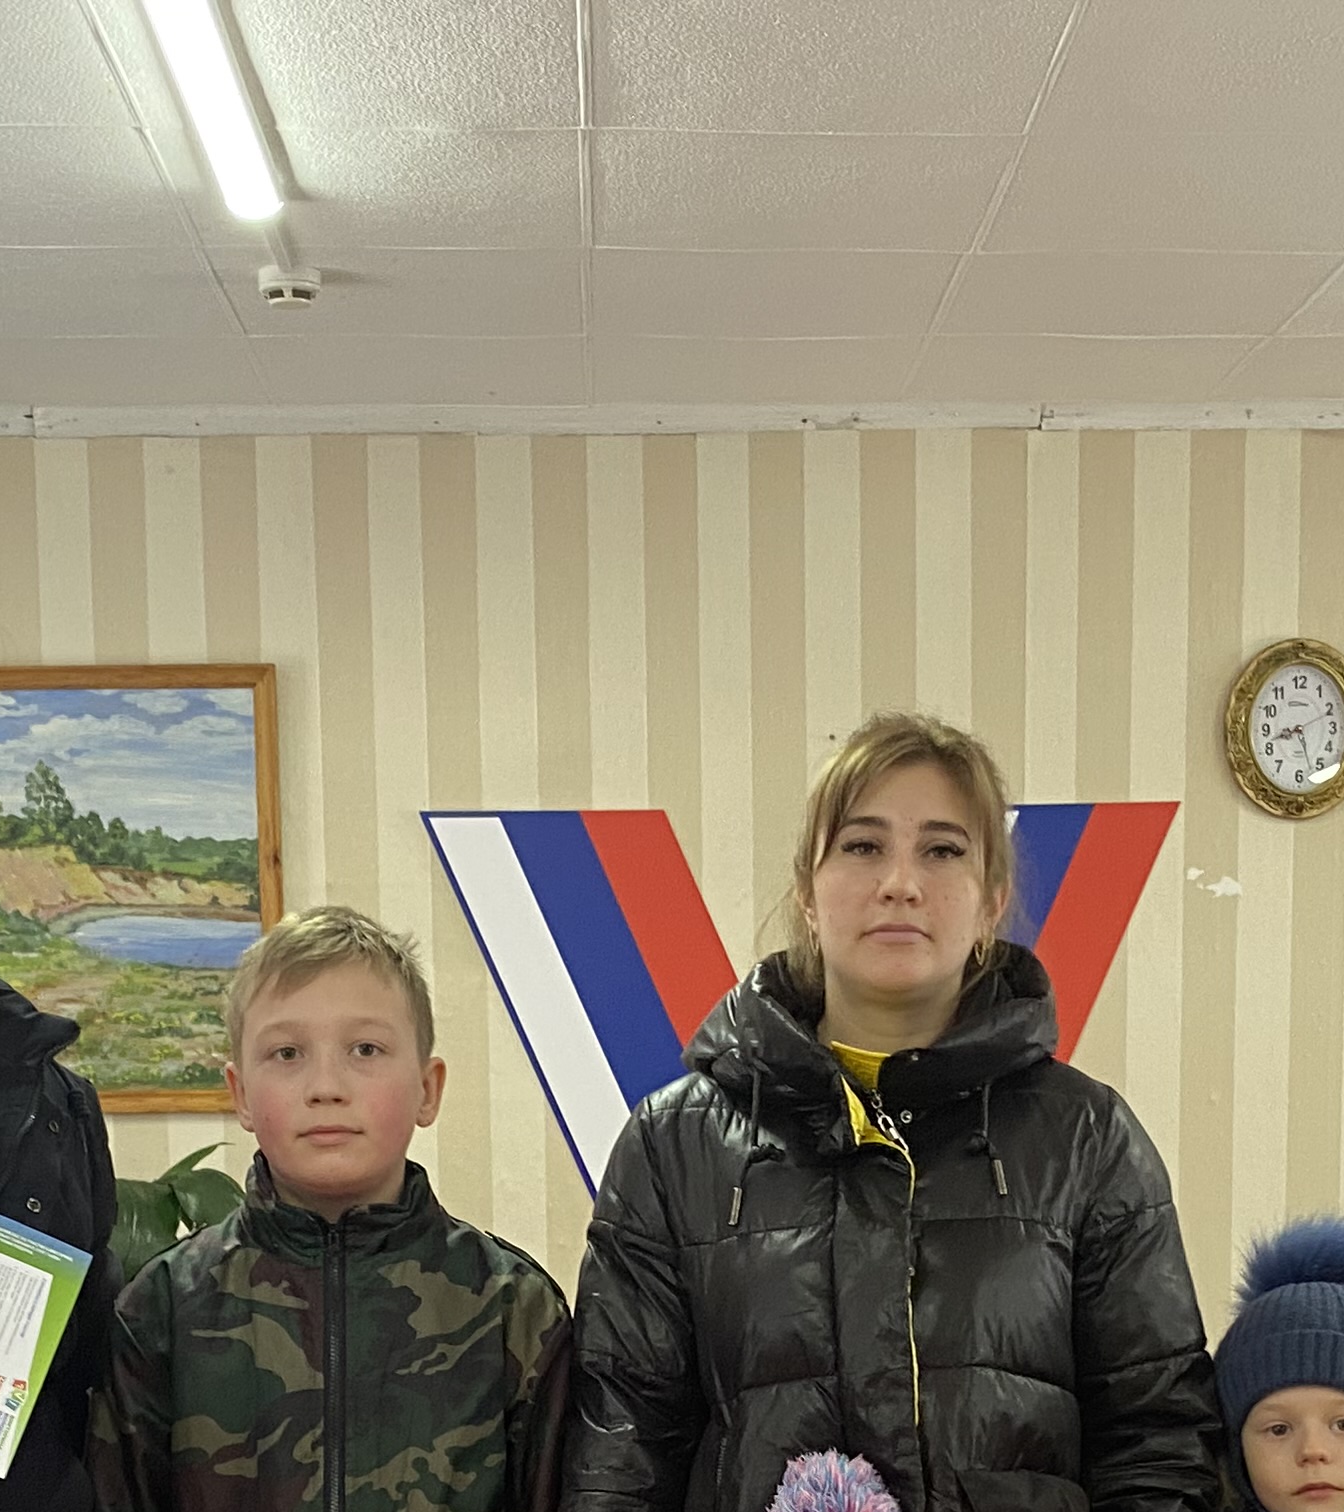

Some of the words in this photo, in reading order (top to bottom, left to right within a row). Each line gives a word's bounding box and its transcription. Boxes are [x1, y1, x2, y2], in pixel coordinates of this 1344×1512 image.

[1292, 676, 1307, 689] 12
[1272, 686, 1284, 699] 11
[1316, 685, 1322, 698] 1
[1263, 704, 1276, 718] 10
[1325, 703, 1333, 715] 2
[1262, 724, 1270, 736] 9
[1329, 721, 1337, 734] 3
[1265, 742, 1273, 755] 8
[1325, 741, 1333, 752] 4
[1275, 760, 1283, 773] 7
[1316, 758, 1324, 770] 5
[1295, 770, 1303, 783] 6
